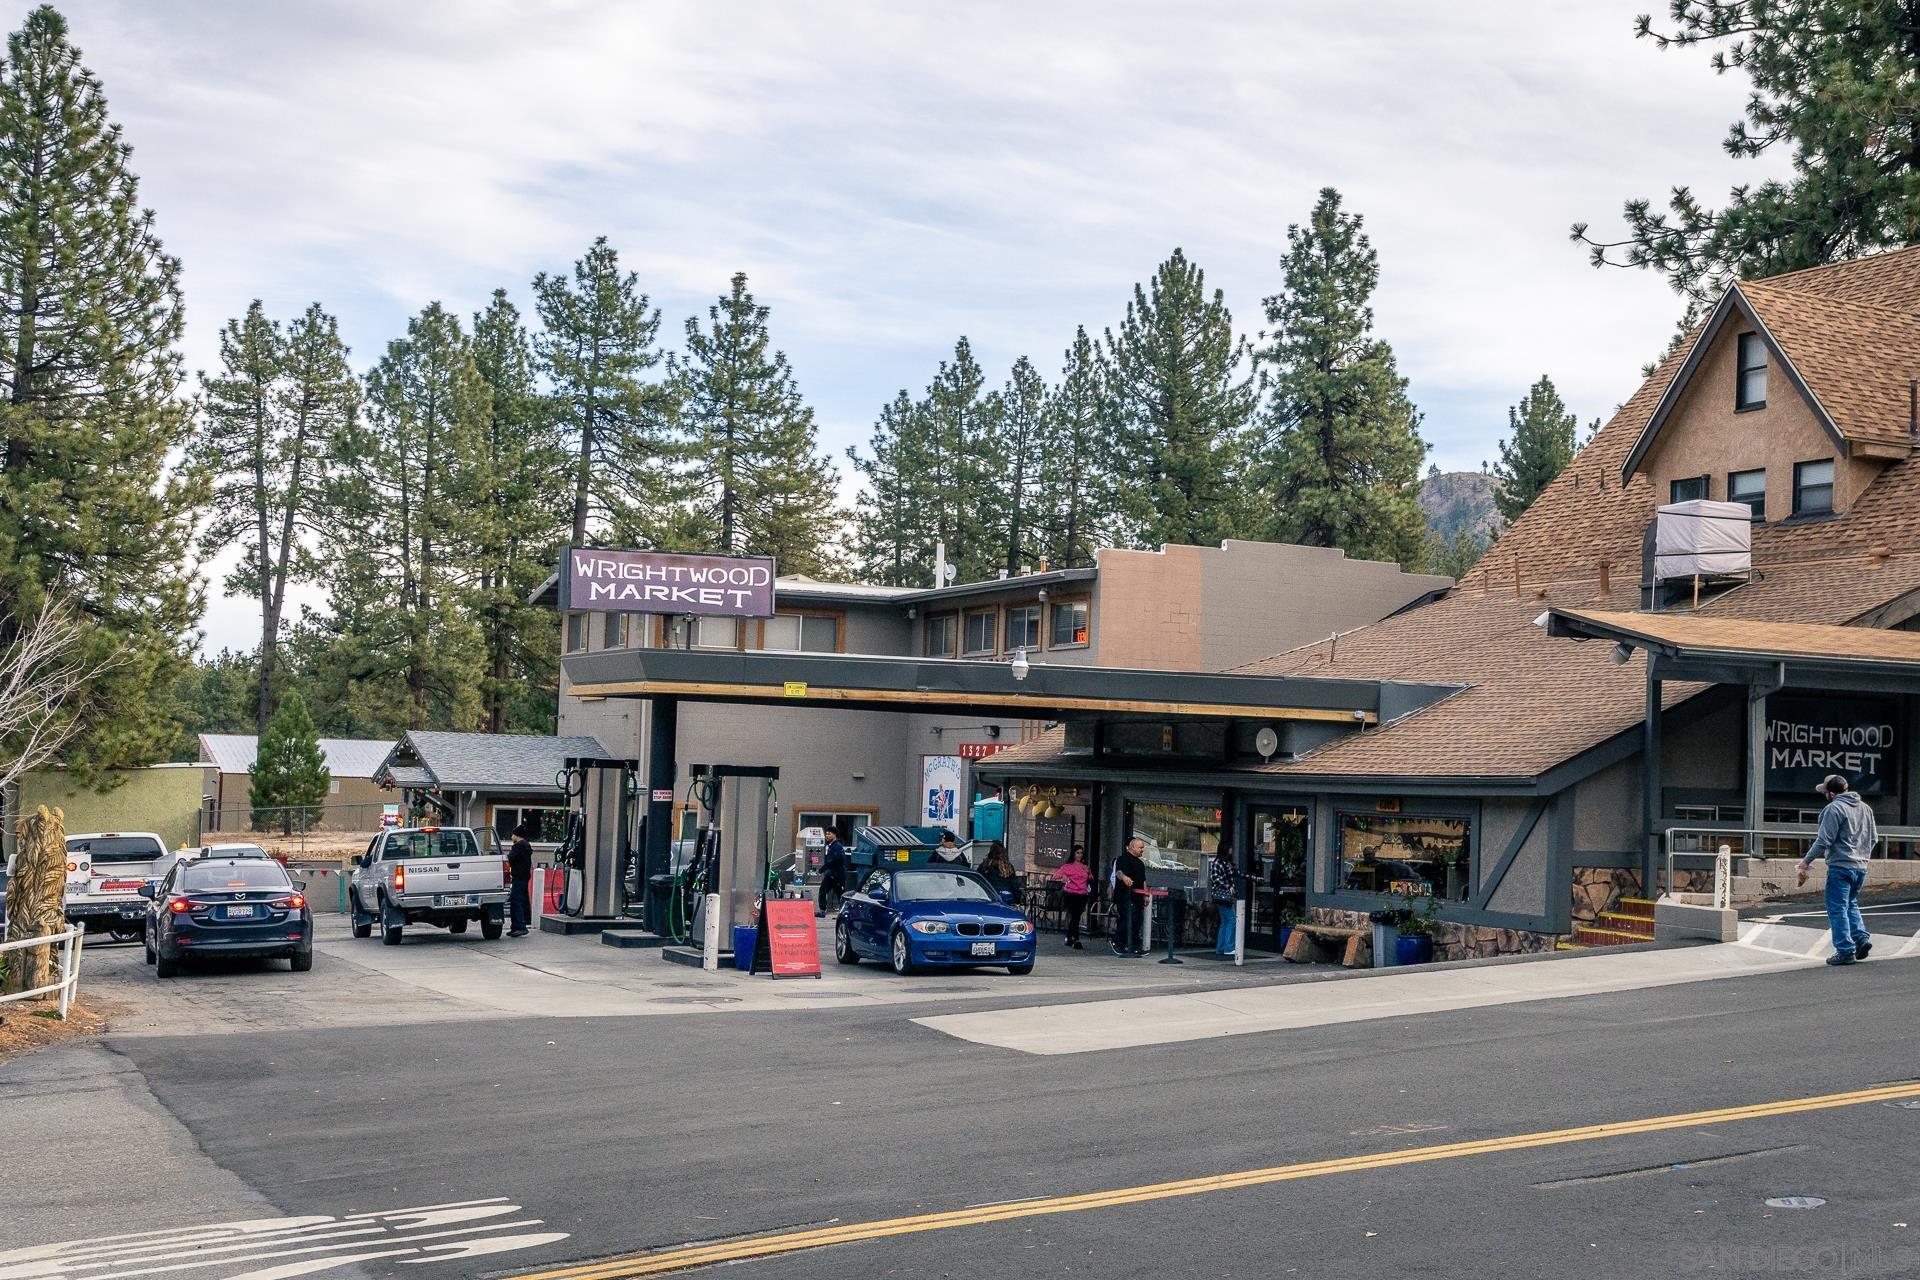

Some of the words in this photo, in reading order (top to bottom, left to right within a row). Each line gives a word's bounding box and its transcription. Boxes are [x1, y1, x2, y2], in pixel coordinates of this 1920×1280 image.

[574, 555, 770, 587] WRIGHTWOOD
[588, 582, 753, 609] MARKET
[1765, 719, 1894, 748] WRIGHTWOOD
[962, 745, 987, 757] 1327
[1771, 747, 1882, 774] MARKET
[624, 761, 630, 769] 3
[408, 866, 440, 874] NISSAN
